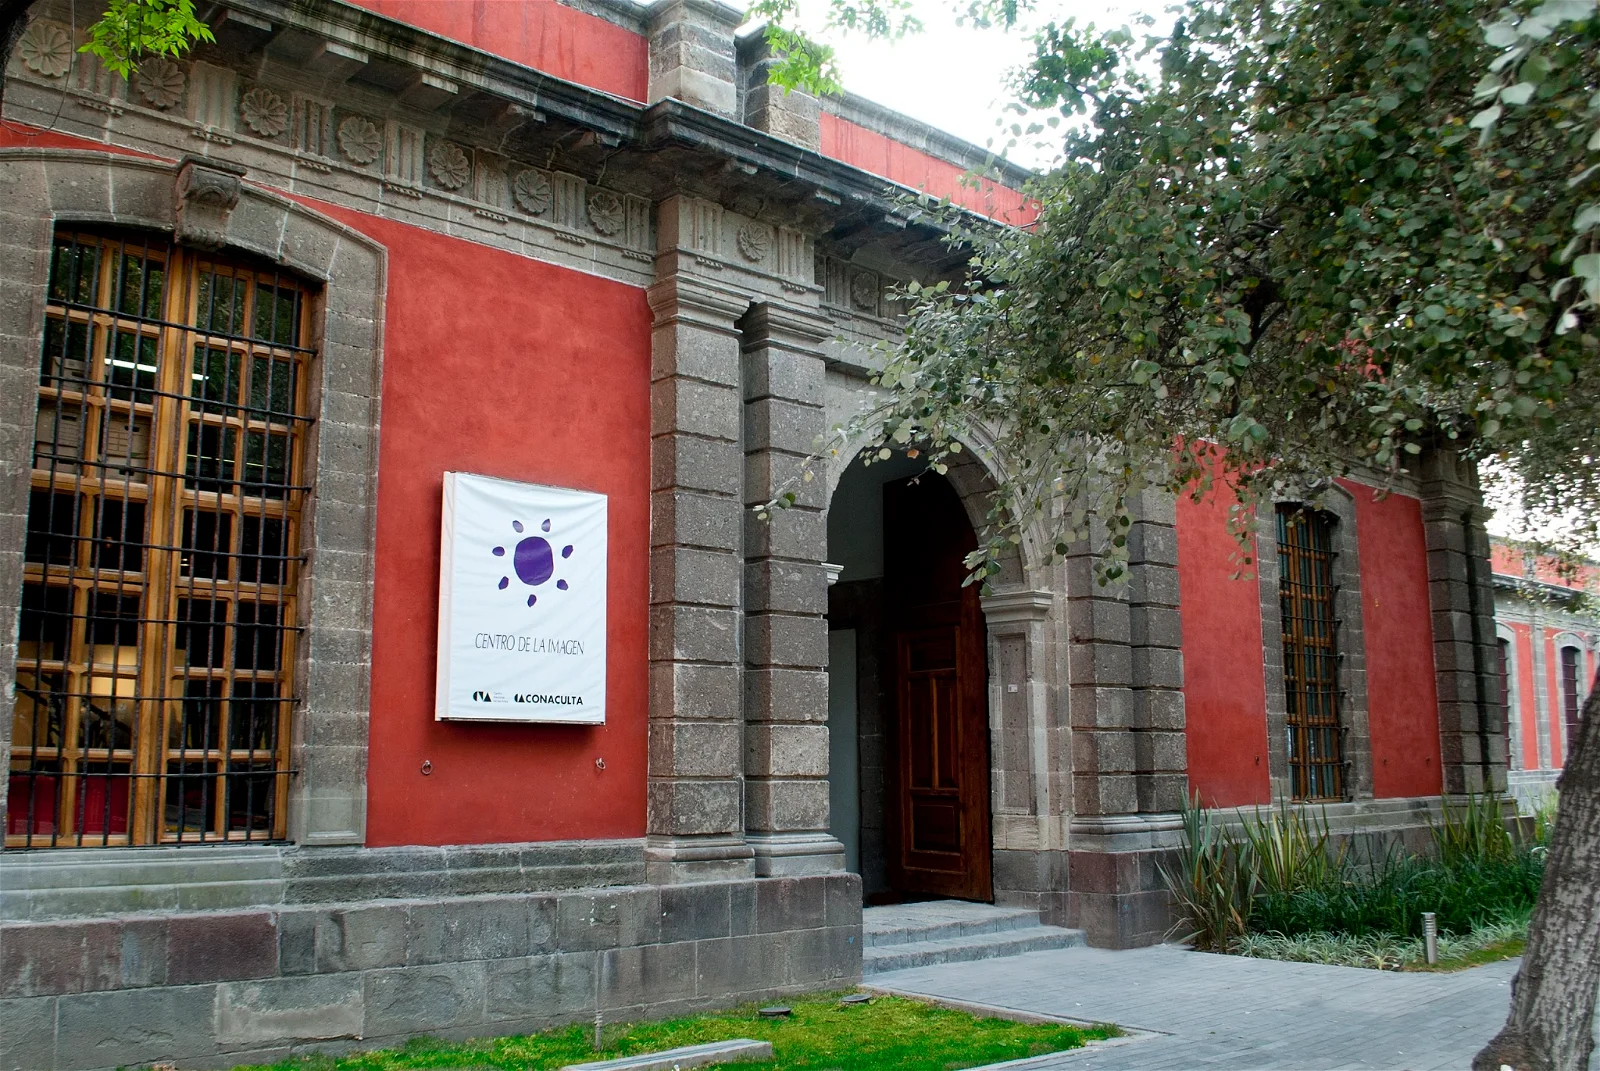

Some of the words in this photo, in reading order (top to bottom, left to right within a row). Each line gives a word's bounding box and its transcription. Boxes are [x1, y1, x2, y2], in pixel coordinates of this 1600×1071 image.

[475, 632, 516, 651] CENTRO
[517, 636, 531, 652] DE
[533, 637, 546, 653] LA
[547, 638, 585, 655] IMAGEN
[525, 694, 584, 705] CONACULTA
